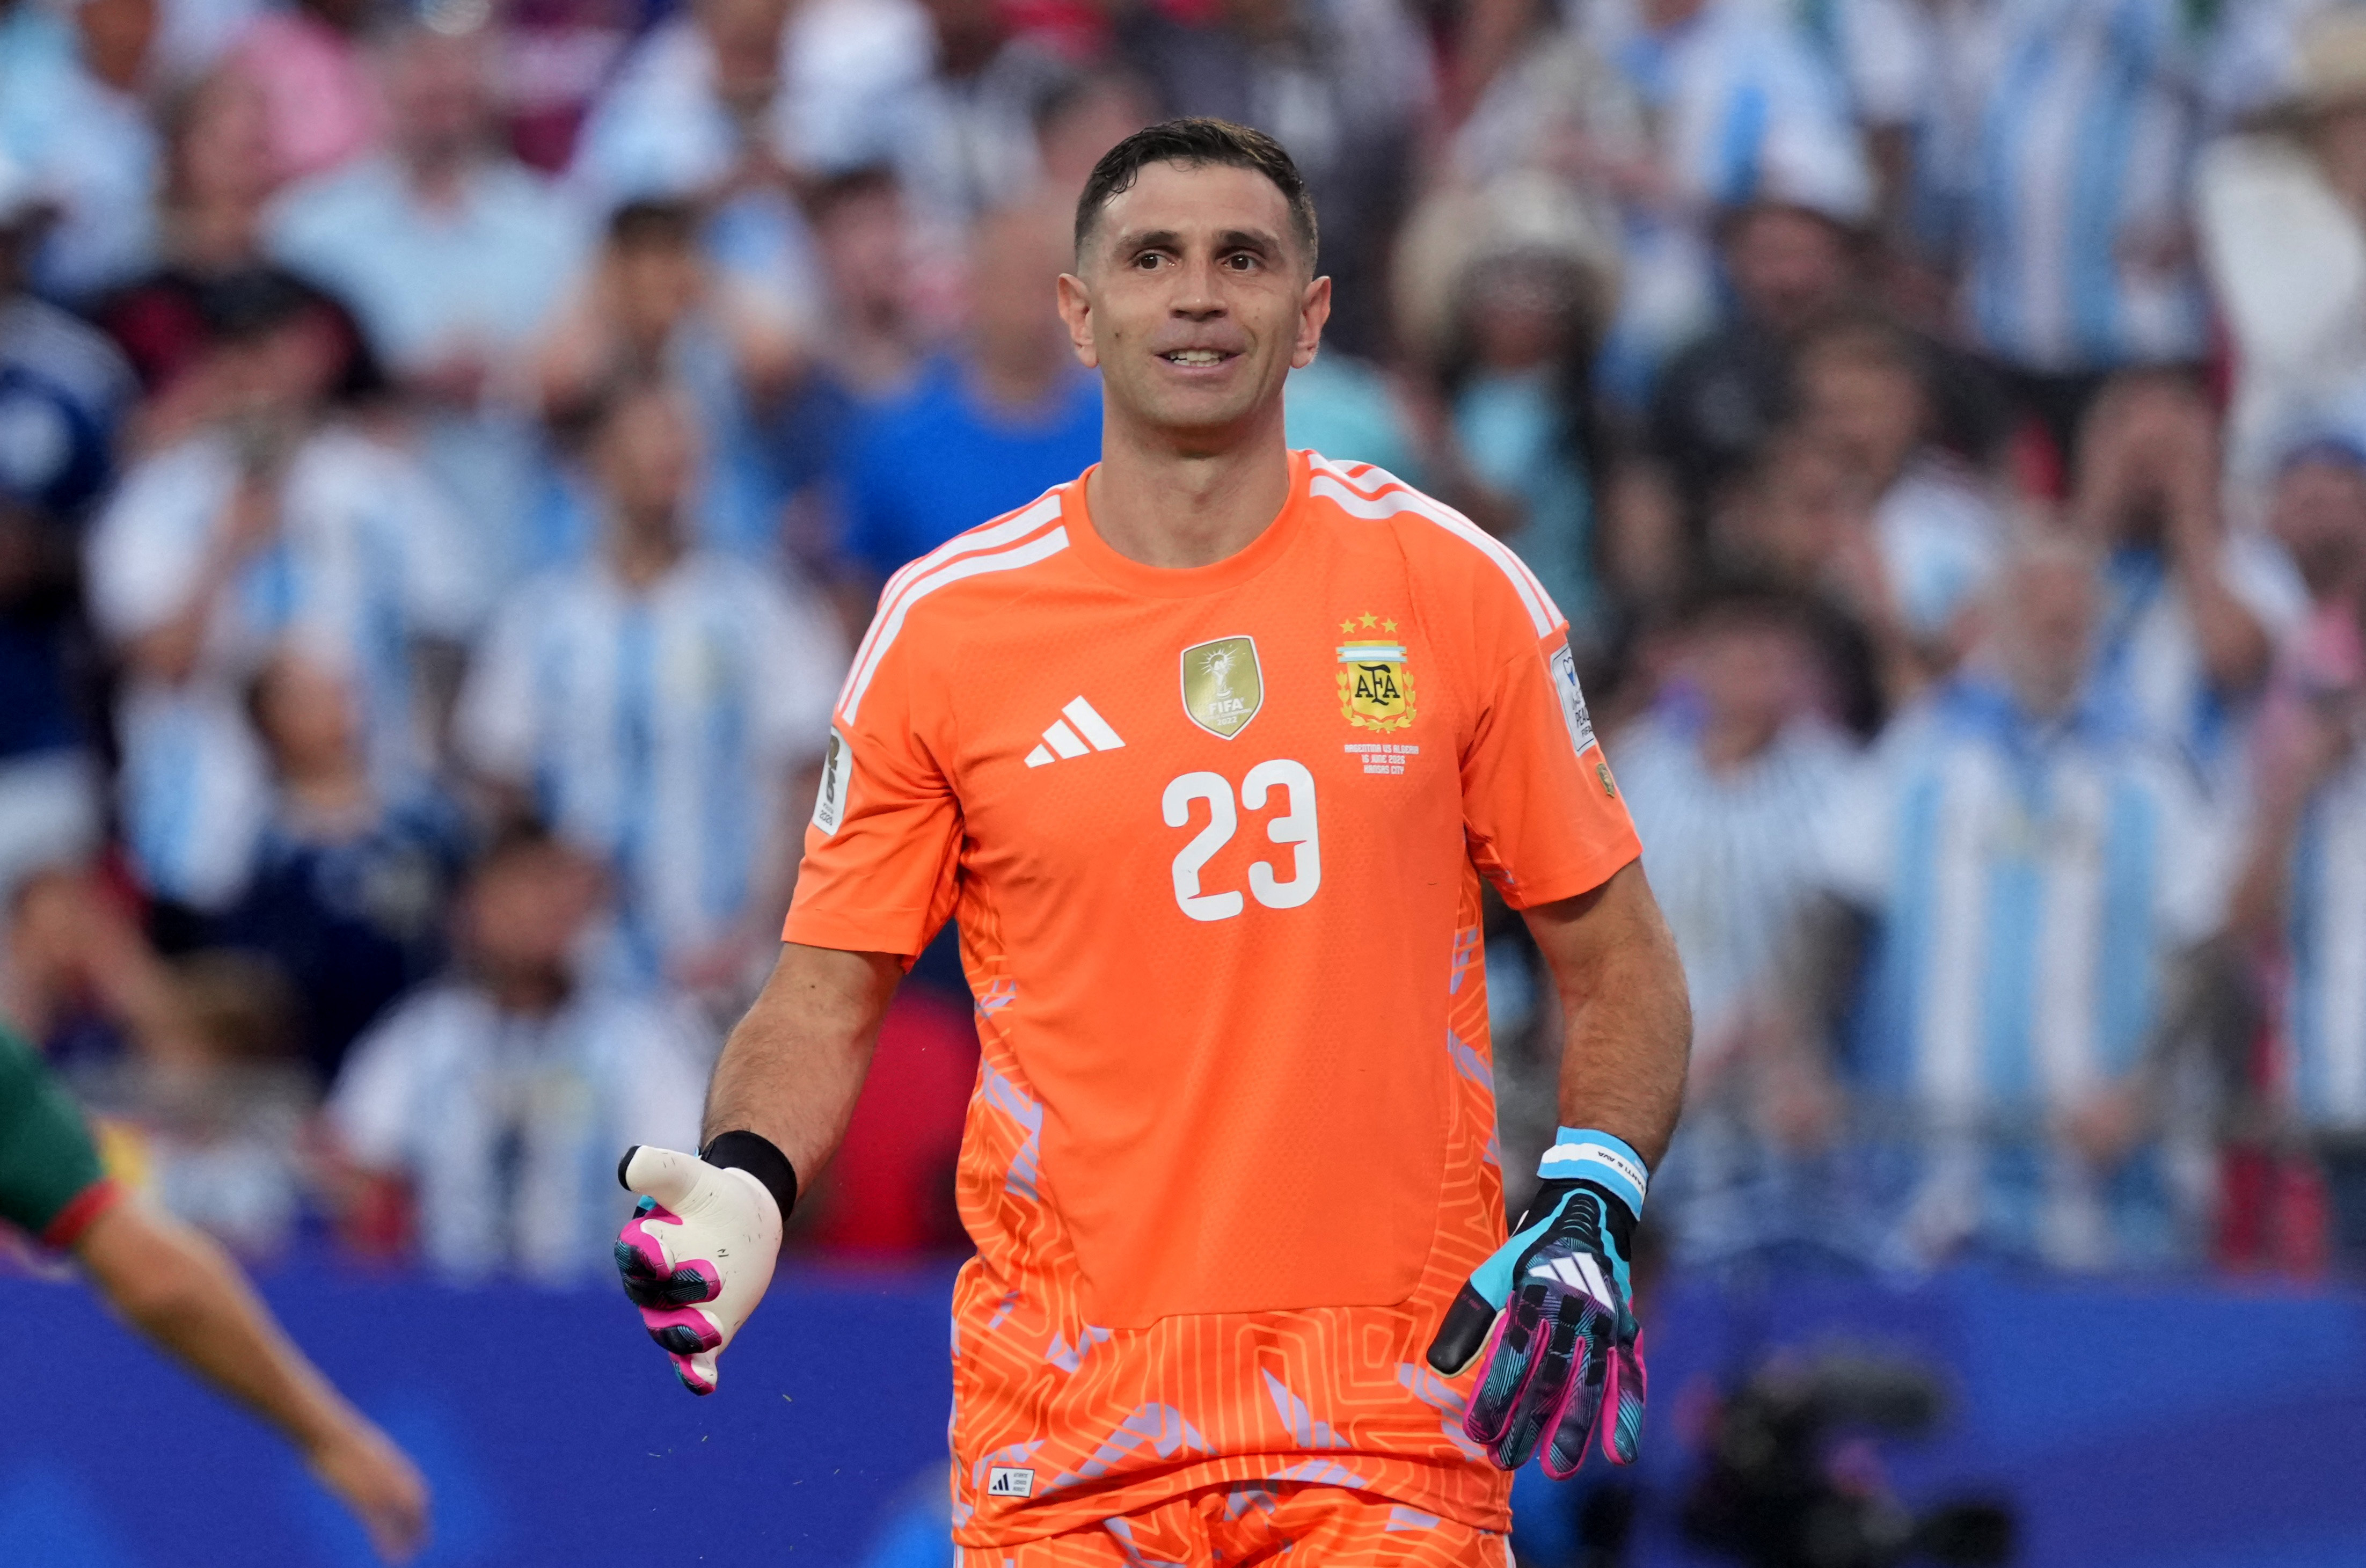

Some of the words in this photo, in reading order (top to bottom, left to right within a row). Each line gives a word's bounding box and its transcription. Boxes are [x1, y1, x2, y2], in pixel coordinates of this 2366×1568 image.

[1355, 664, 1400, 706] AFA
[1208, 698, 1244, 714] FIFA
[1217, 717, 1237, 726] 2022
[1162, 759, 1321, 922] 23
[1598, 1151, 1616, 1162] AVA
